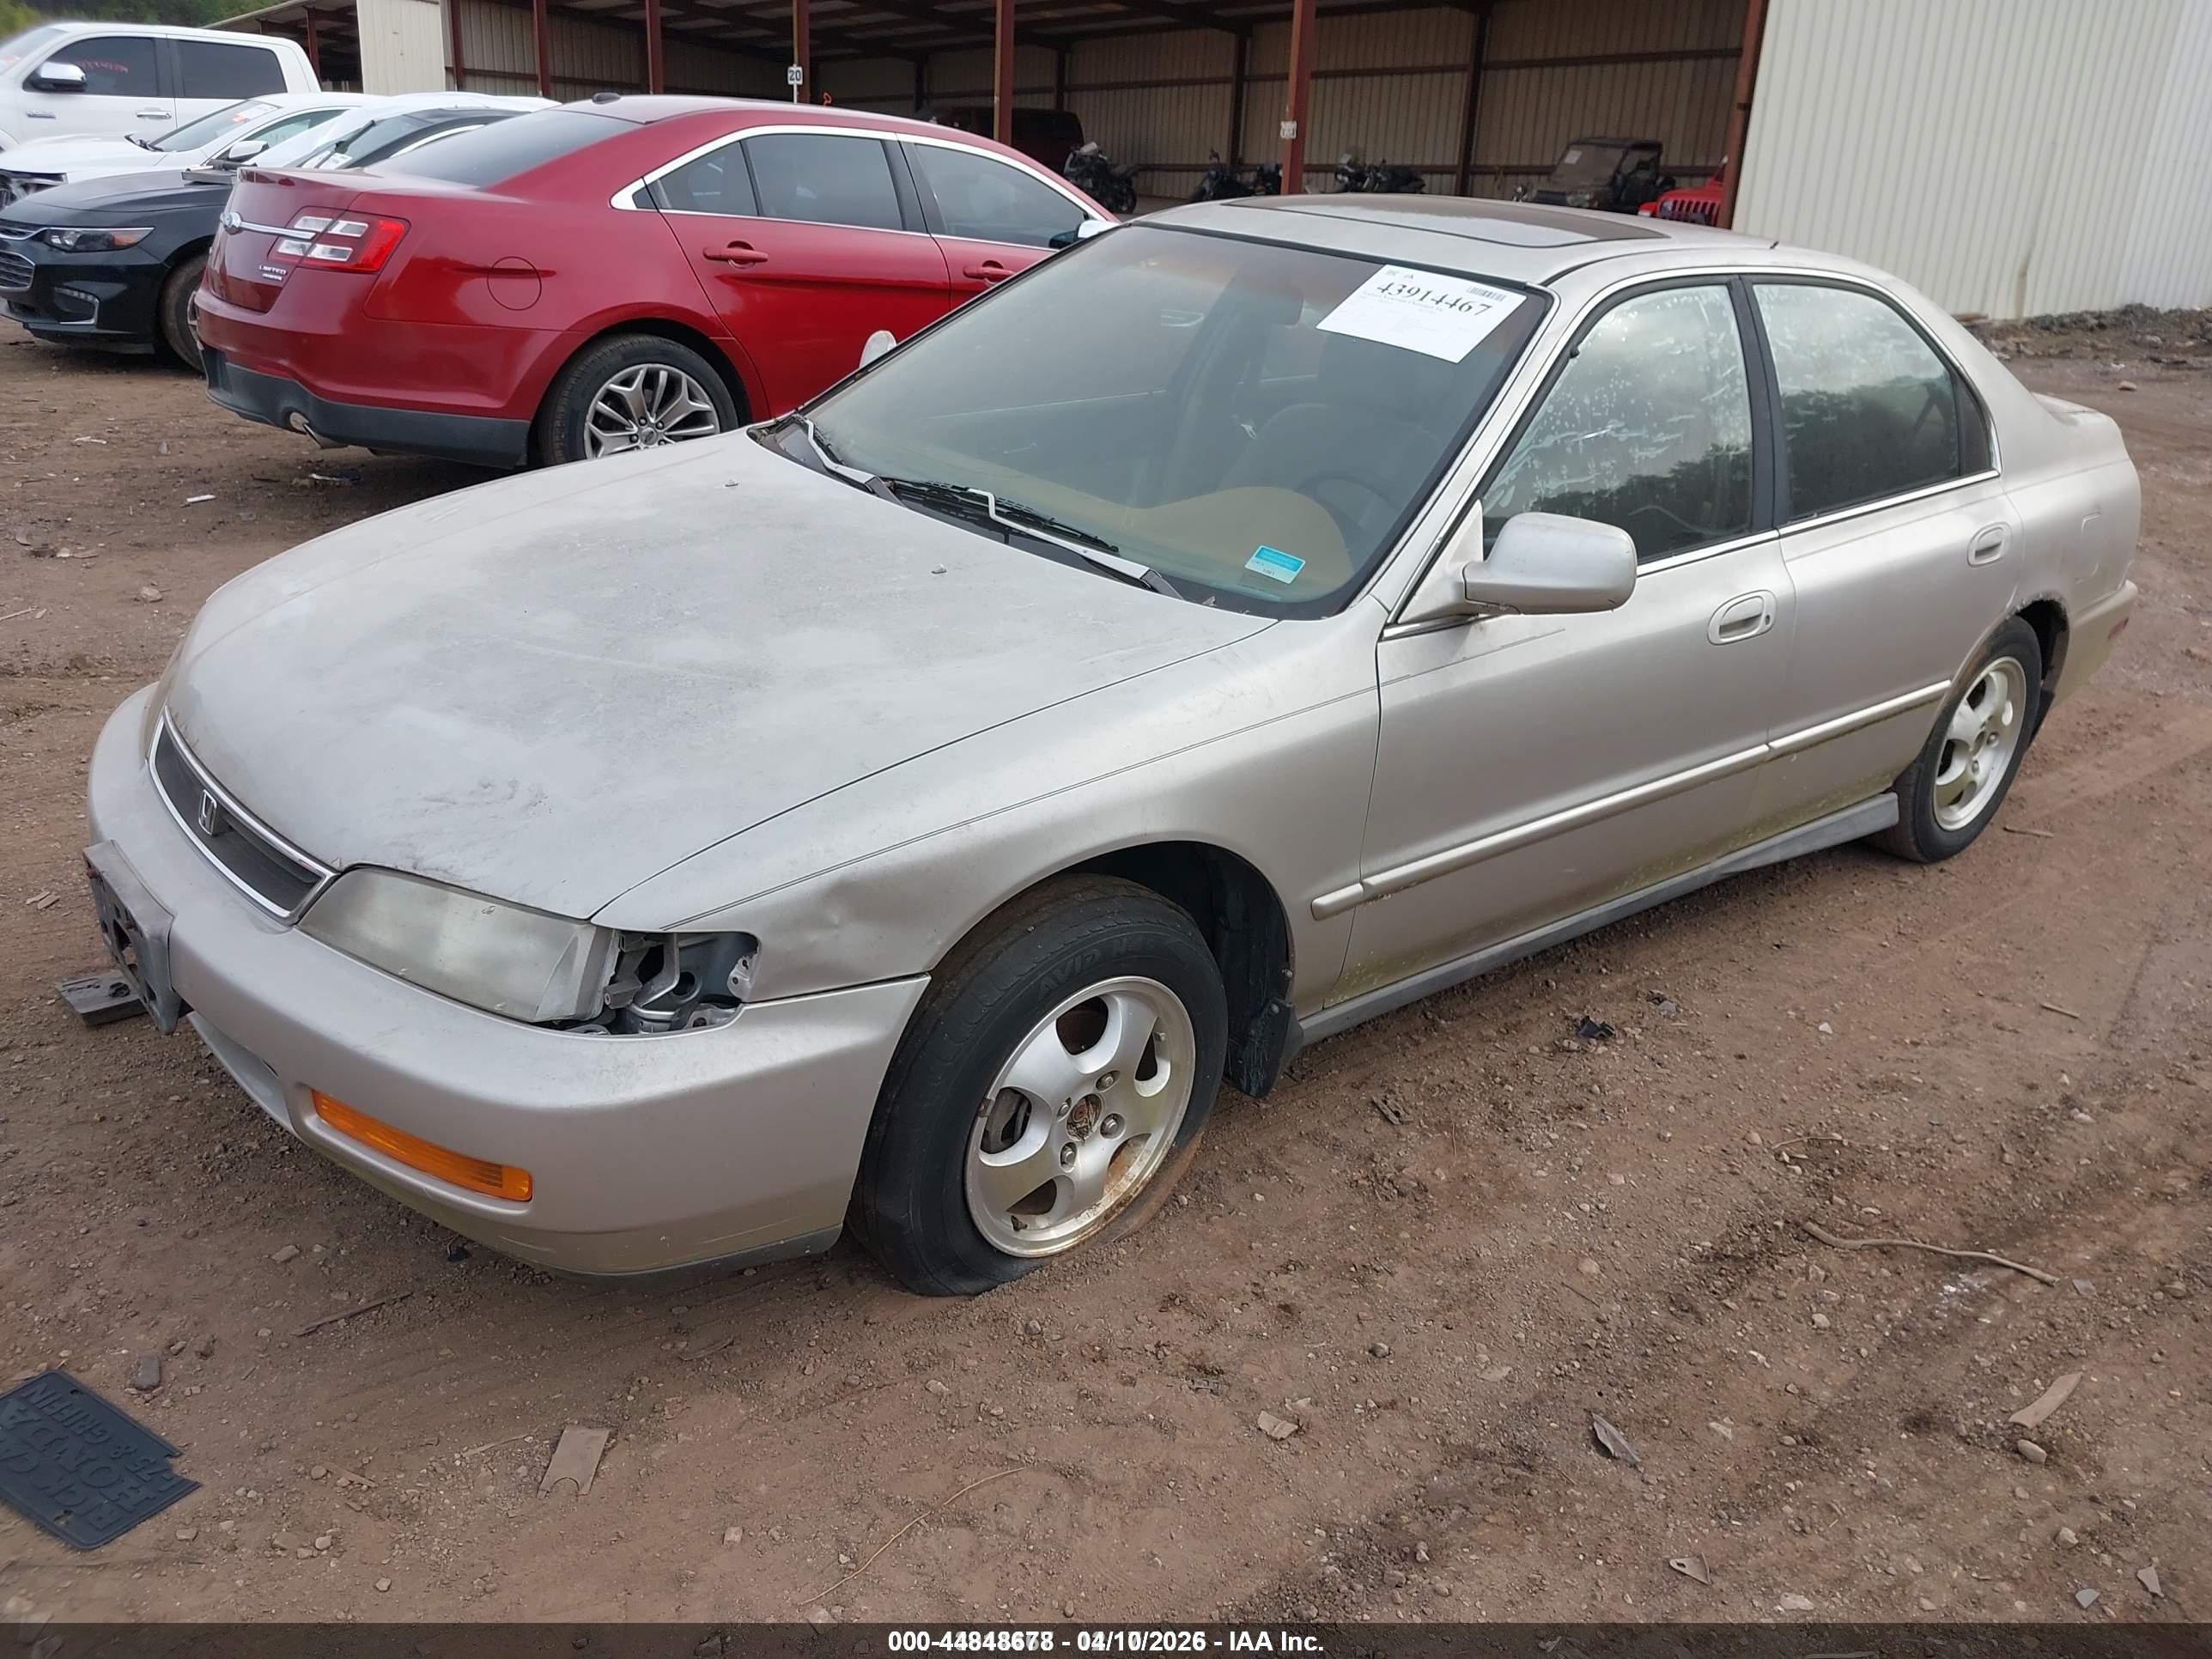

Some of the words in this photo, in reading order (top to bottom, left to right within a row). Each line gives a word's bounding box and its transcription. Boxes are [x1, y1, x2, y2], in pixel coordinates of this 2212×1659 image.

[789, 70, 801, 82] 20
[1376, 281, 1493, 316] 43914467
[21, 1381, 117, 1448] GRIFFIN
[4, 1407, 157, 1514] HONDA
